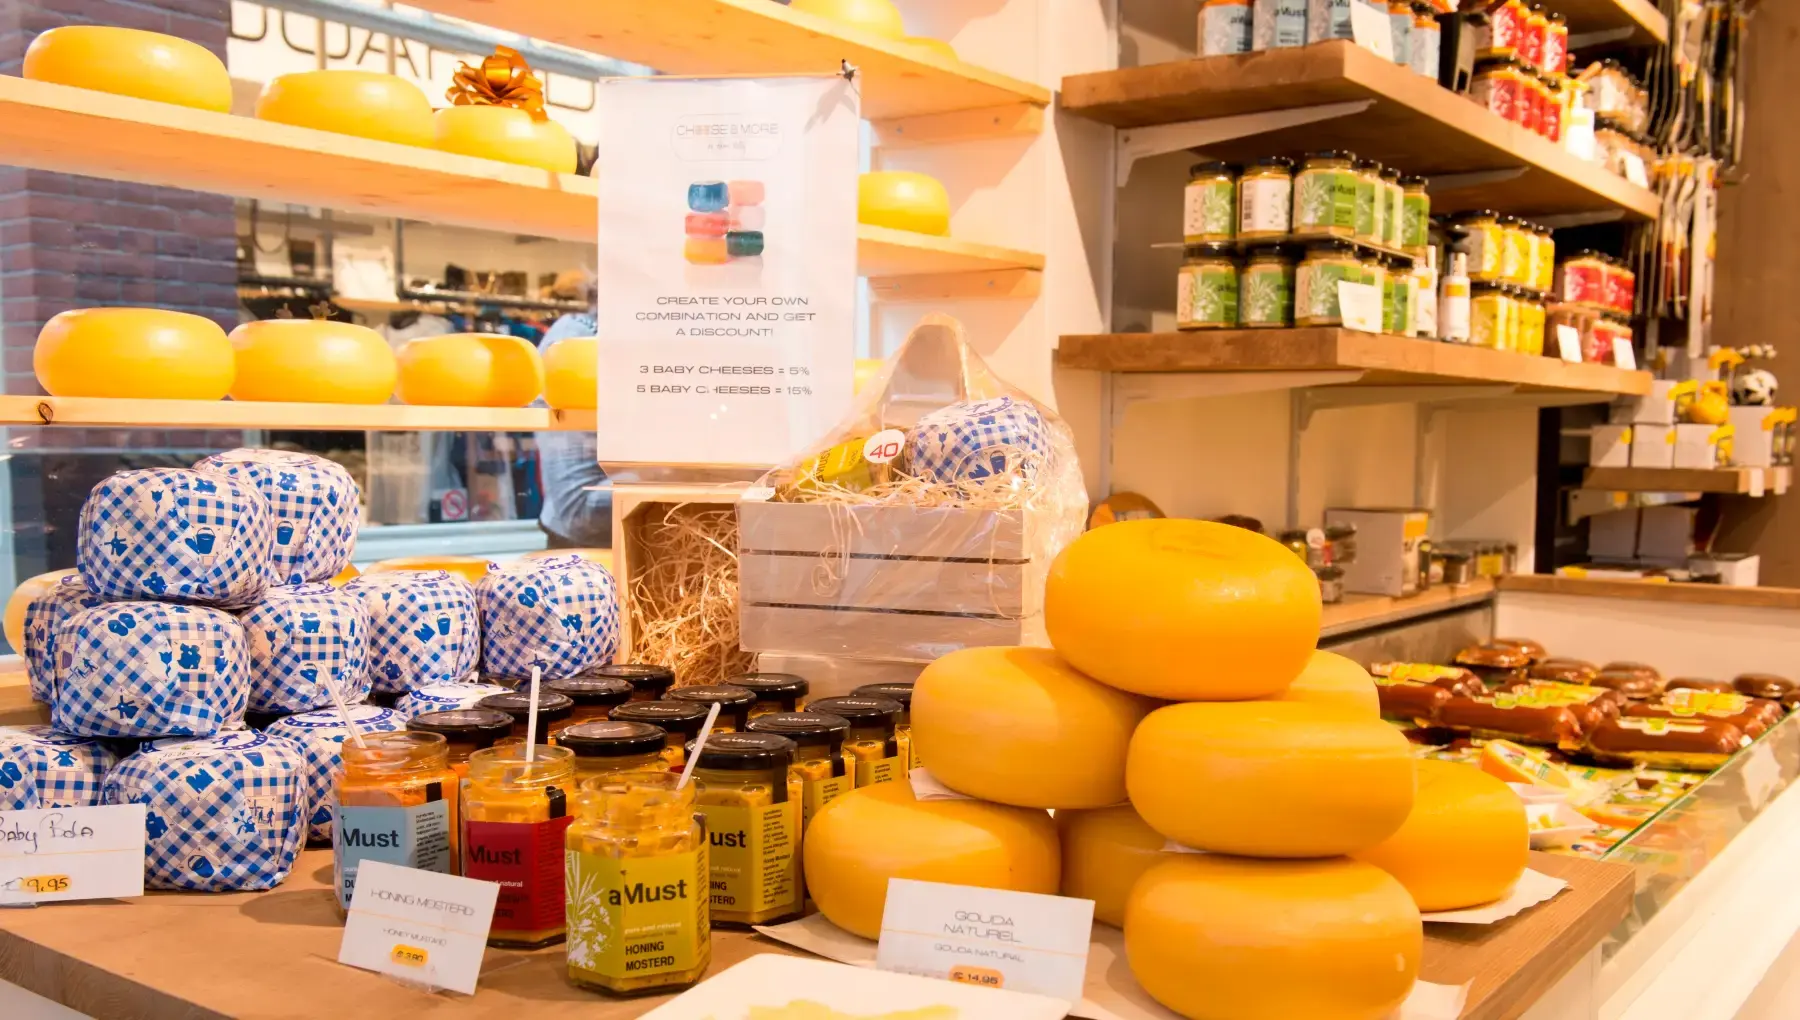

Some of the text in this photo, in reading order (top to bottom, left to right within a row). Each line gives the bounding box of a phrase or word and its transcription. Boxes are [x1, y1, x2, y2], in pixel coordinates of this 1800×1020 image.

[676, 124, 729, 136] CHEESE
[740, 123, 779, 135] MORE
[656, 296, 809, 306] CREATE YOUR OWN
[635, 311, 816, 322] COMBINATION AND GET
[675, 327, 774, 338] A DISCOUNT!
[639, 365, 649, 375] 3
[653, 365, 694, 375] BABY
[698, 365, 774, 376] CHEESES
[789, 366, 810, 376] 5%
[636, 384, 646, 394] 5
[650, 384, 691, 394] BABY
[787, 385, 813, 395] 15%
[869, 442, 899, 459] 40
[342, 828, 400, 848] Must
[710, 829, 747, 848] ust
[469, 845, 522, 865] Must
[370, 888, 415, 905] HONING
[608, 879, 688, 906] aMust
[954, 910, 1015, 927] GOUDA
[943, 922, 1023, 944] NATUREL
[625, 940, 665, 956] HONING
[934, 942, 1024, 964] GOUDA NATURAL
[625, 955, 675, 972] MOSTERD
